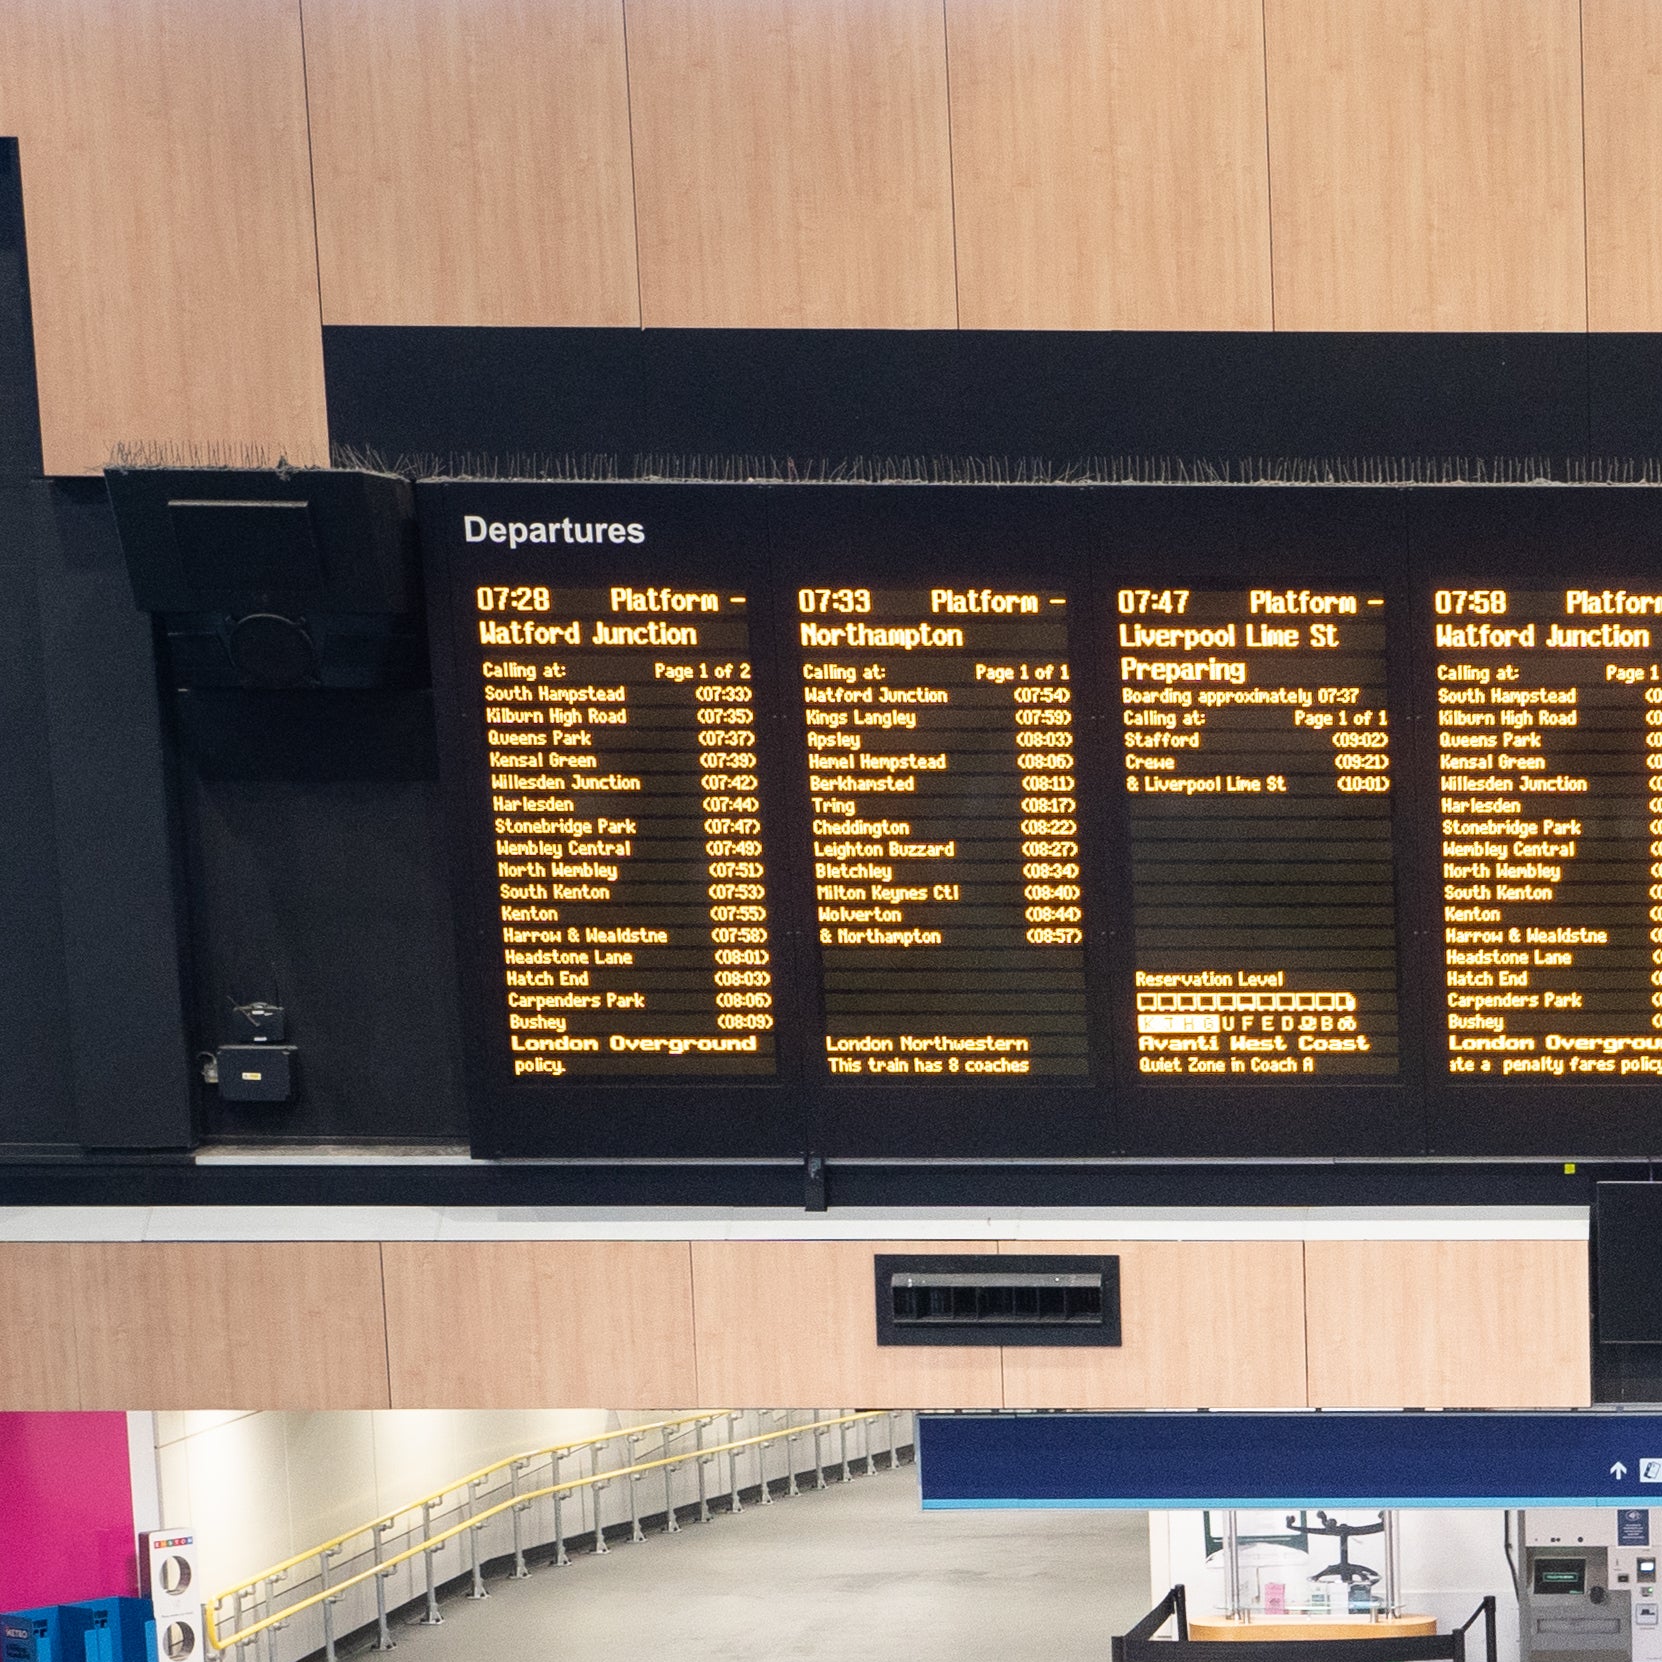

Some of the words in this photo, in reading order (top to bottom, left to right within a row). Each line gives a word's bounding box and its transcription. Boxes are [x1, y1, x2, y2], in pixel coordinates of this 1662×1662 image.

[463, 515, 646, 550] Departures
[476, 586, 551, 612] 07:28
[610, 587, 719, 612] Platform
[798, 588, 872, 613] 07:33
[931, 588, 1039, 614] Platform
[1117, 589, 1190, 614] 07:47
[1249, 589, 1357, 615] Platform
[1434, 590, 1507, 615] 07:58
[479, 620, 581, 645] Watford
[592, 621, 698, 646] Junction
[800, 622, 964, 651] Northampton
[1119, 623, 1236, 651] Liverpool
[1245, 623, 1300, 648] Lime
[1309, 623, 1340, 648] St
[1435, 623, 1535, 648] Watford
[1545, 623, 1651, 648] Junction
[1120, 656, 1247, 685] Preparing
[484, 685, 533, 702] South
[537, 685, 626, 705] Hampstead
[486, 707, 544, 724] Kilburn
[548, 707, 583, 728] High
[587, 707, 627, 724] Road
[808, 753, 856, 770] Hemel
[859, 753, 947, 773] Hempstead
[1442, 818, 1539, 839] Stonebridge
[1542, 818, 1582, 836] Park
[511, 1035, 599, 1051] London
[609, 1035, 758, 1055] Overground
[825, 1035, 894, 1052] London
[899, 1035, 1029, 1052] Northwestern
[1138, 1034, 1220, 1052] Avanti
[1229, 1034, 1288, 1052] West
[1297, 1034, 1371, 1052] Coast
